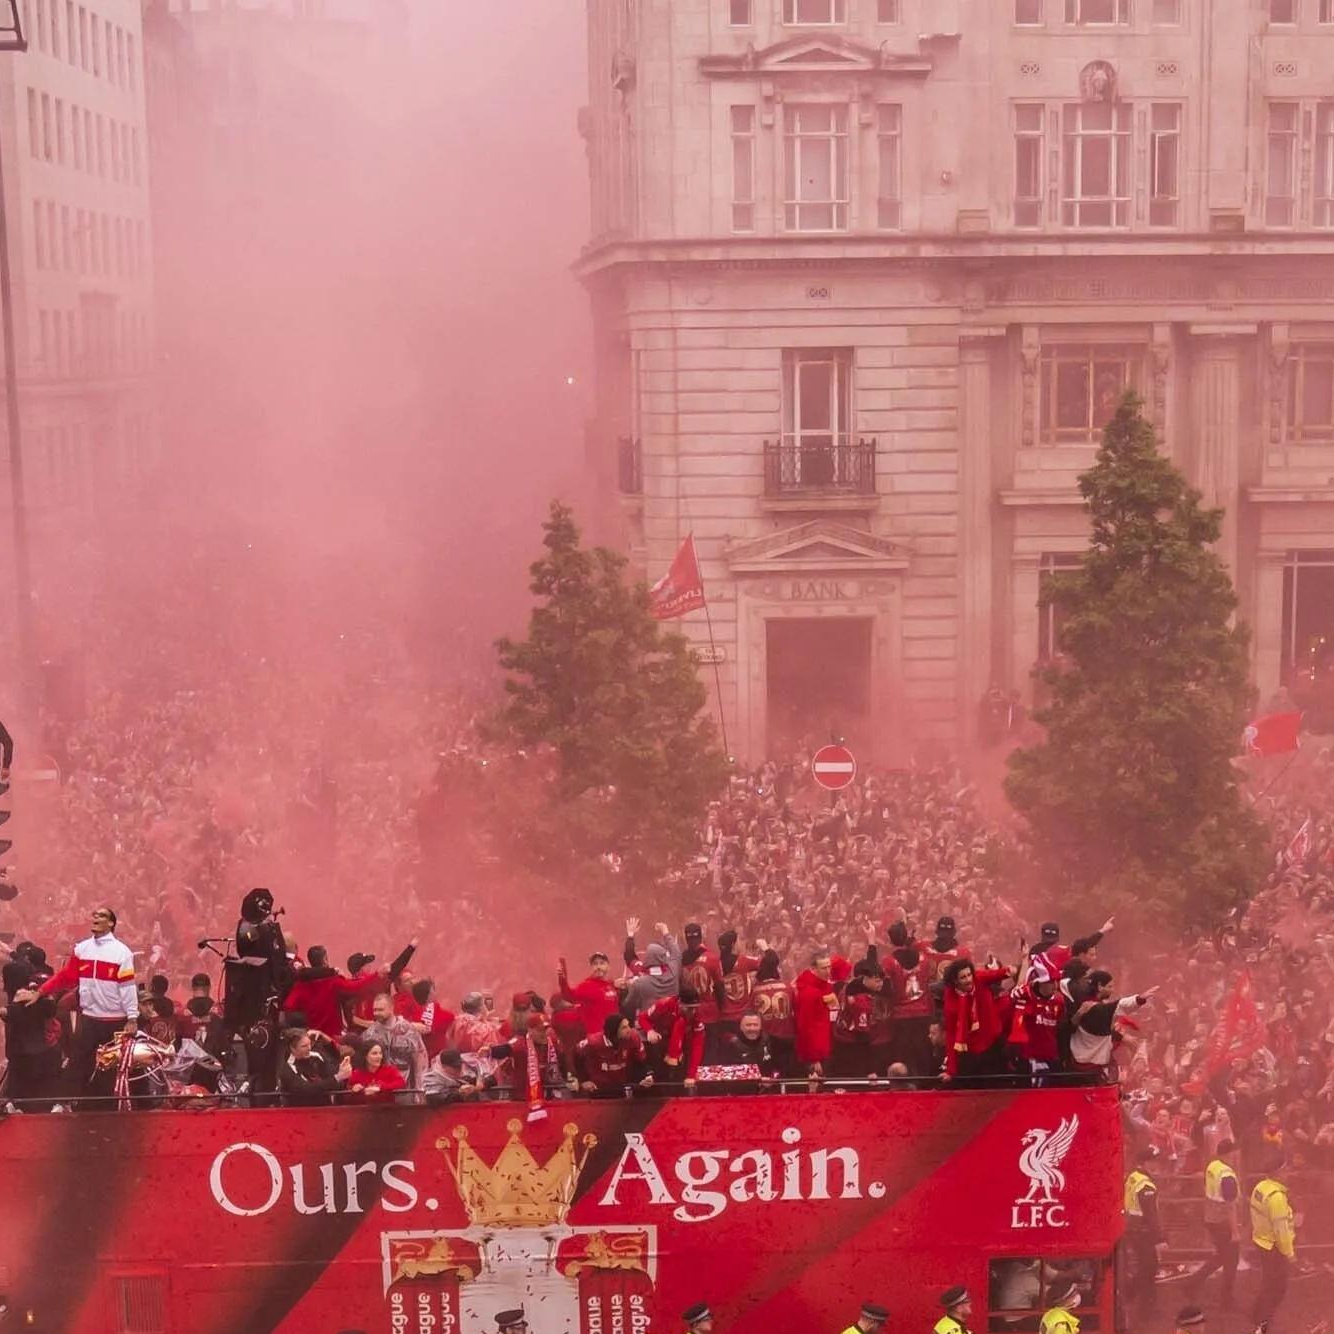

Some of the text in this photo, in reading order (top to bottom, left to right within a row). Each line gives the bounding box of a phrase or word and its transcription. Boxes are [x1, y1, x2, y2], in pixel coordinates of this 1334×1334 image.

[791, 582, 847, 600] BANK
[209, 1128, 887, 1222] Ours. Again.
[1011, 1206, 1070, 1228] L.F.C.
